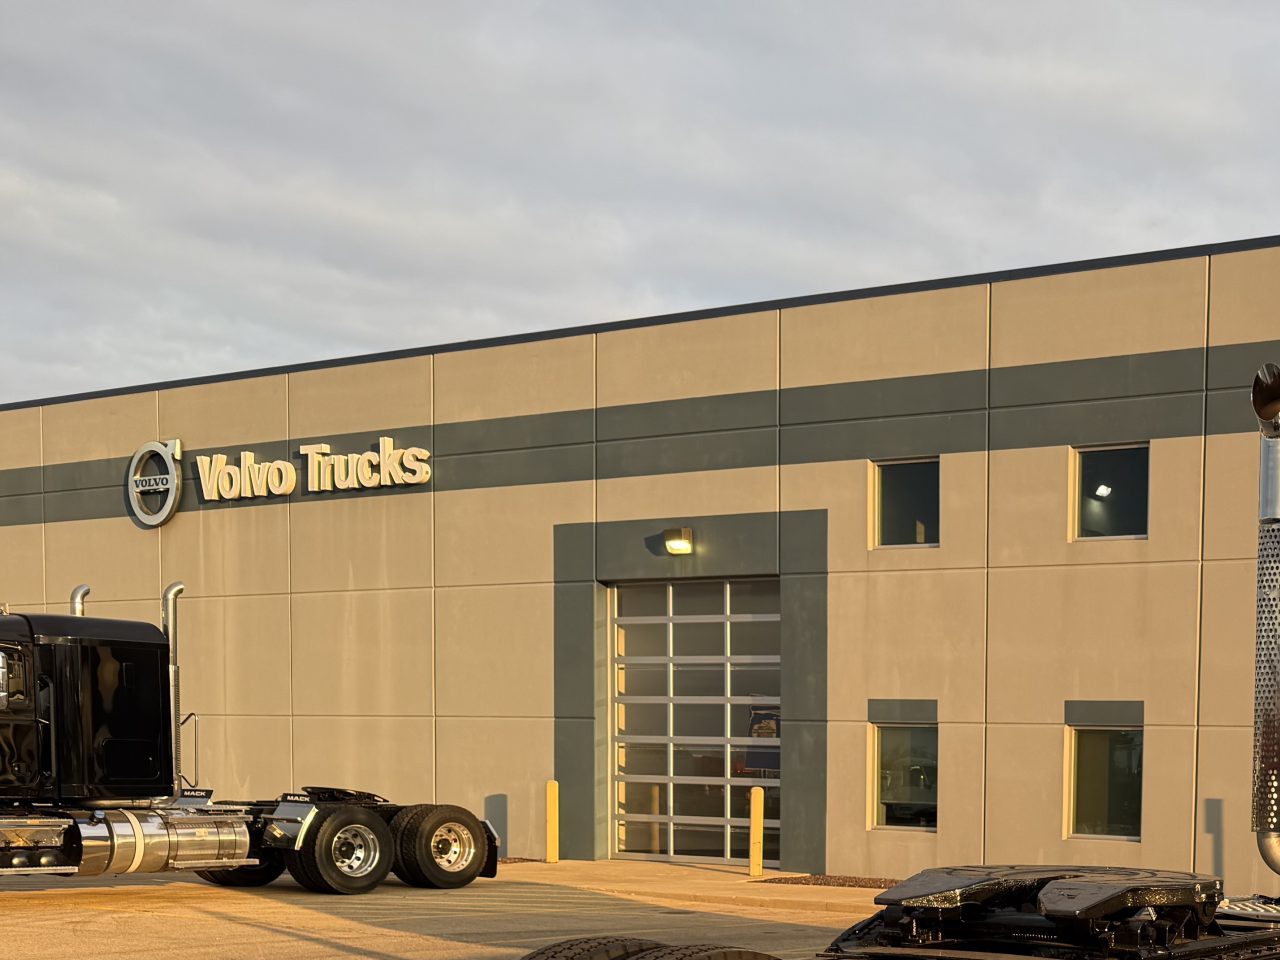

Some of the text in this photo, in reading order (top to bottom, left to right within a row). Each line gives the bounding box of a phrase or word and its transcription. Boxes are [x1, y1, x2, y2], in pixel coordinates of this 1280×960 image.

[134, 477, 169, 489] VOLVO
[196, 437, 432, 501] Volvo Trucks
